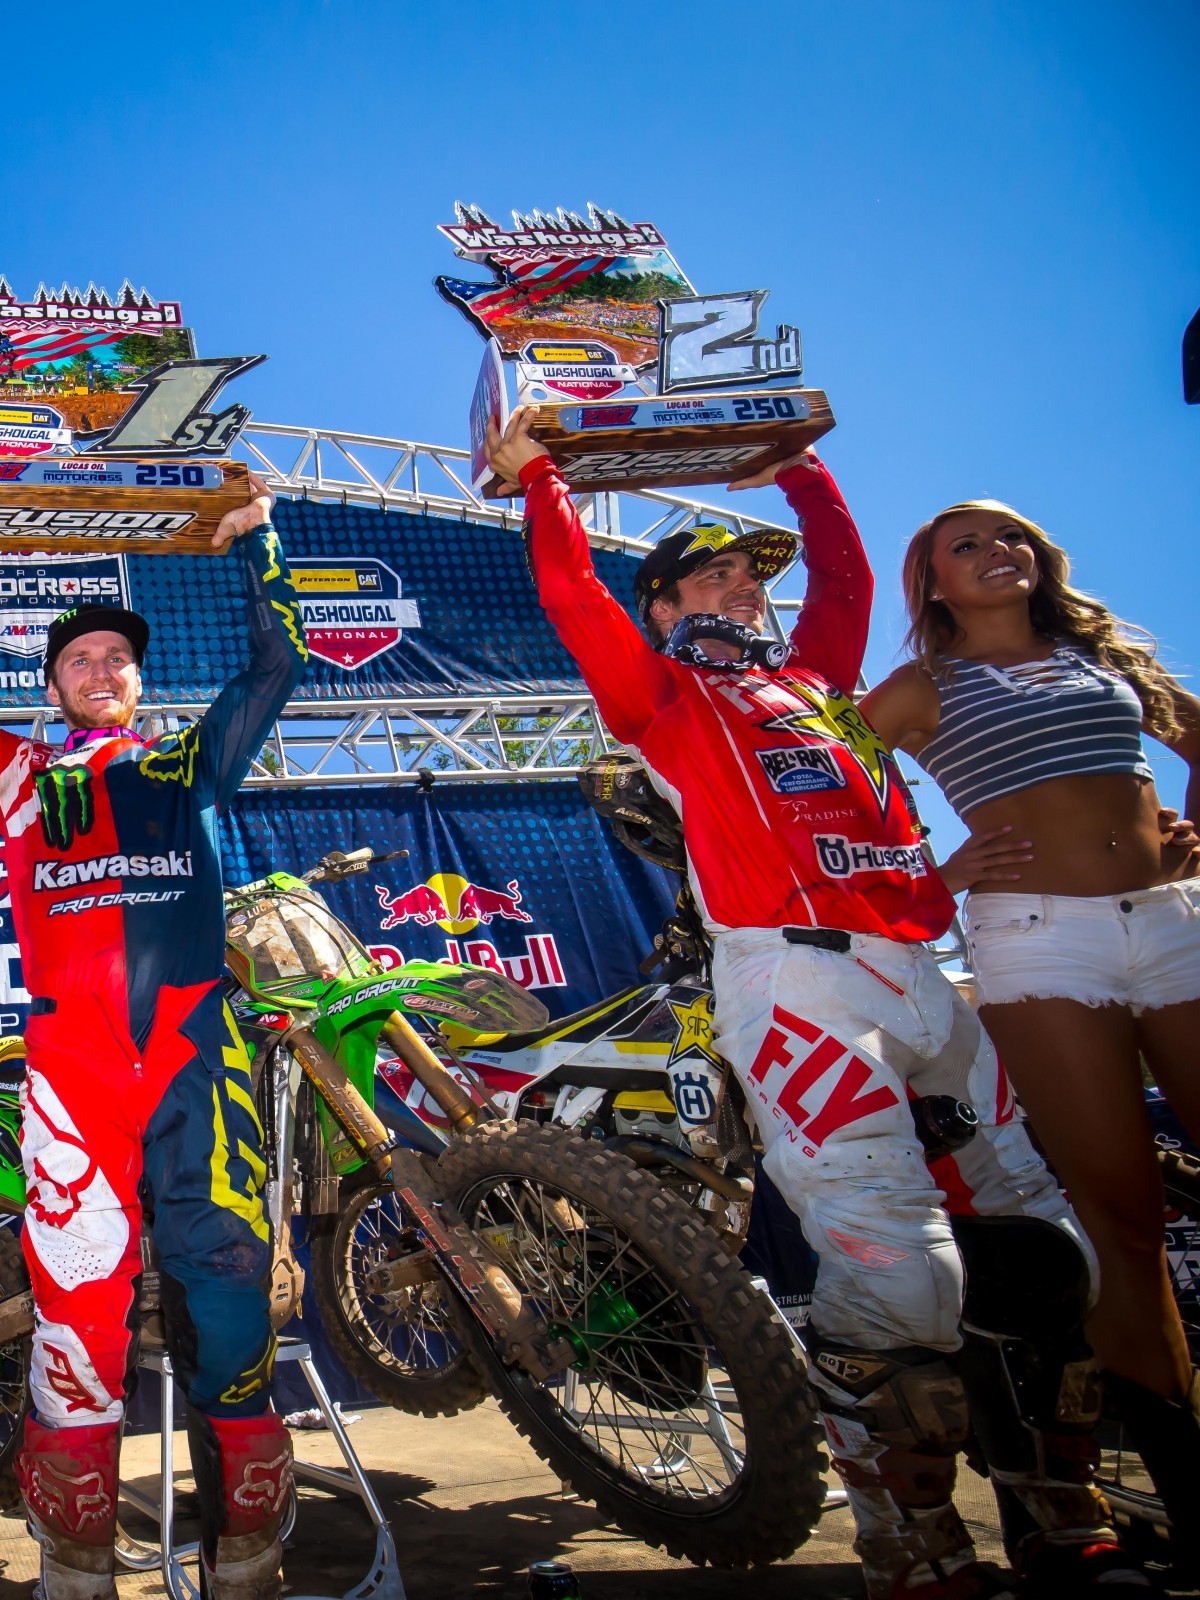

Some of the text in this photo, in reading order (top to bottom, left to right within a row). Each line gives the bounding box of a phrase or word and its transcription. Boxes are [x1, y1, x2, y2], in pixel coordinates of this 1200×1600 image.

[450, 226, 661, 247] Washougal
[587, 351, 603, 359] CAT
[542, 367, 616, 378] WASHOUGAL
[666, 400, 705, 410] LUCAS OIL
[732, 397, 796, 421] 250
[33, 413, 50, 421] CAT
[582, 407, 636, 426] 2017
[652, 410, 725, 422] MOTOCROSS
[43, 473, 123, 482] MOTOCROSS
[135, 465, 204, 486] 250
[298, 574, 378, 586] PETERSON CAT
[303, 605, 397, 623] ASHOUGAL
[0, 624, 36, 636] AMA
[780, 776, 830, 787] PERFORMANCE
[785, 783, 828, 792] LUBRICANTS
[34, 850, 194, 890] Kawasaki
[48, 890, 186, 915] PRO CIRCUIT
[367, 934, 568, 991] Rd Bull
[327, 976, 426, 1017] PRO CIRCUIT
[749, 1002, 901, 1149] FLY
[746, 1074, 817, 1159] RACING
[775, 1293, 813, 1306] STREAM
[42, 1341, 108, 1414] FOX
